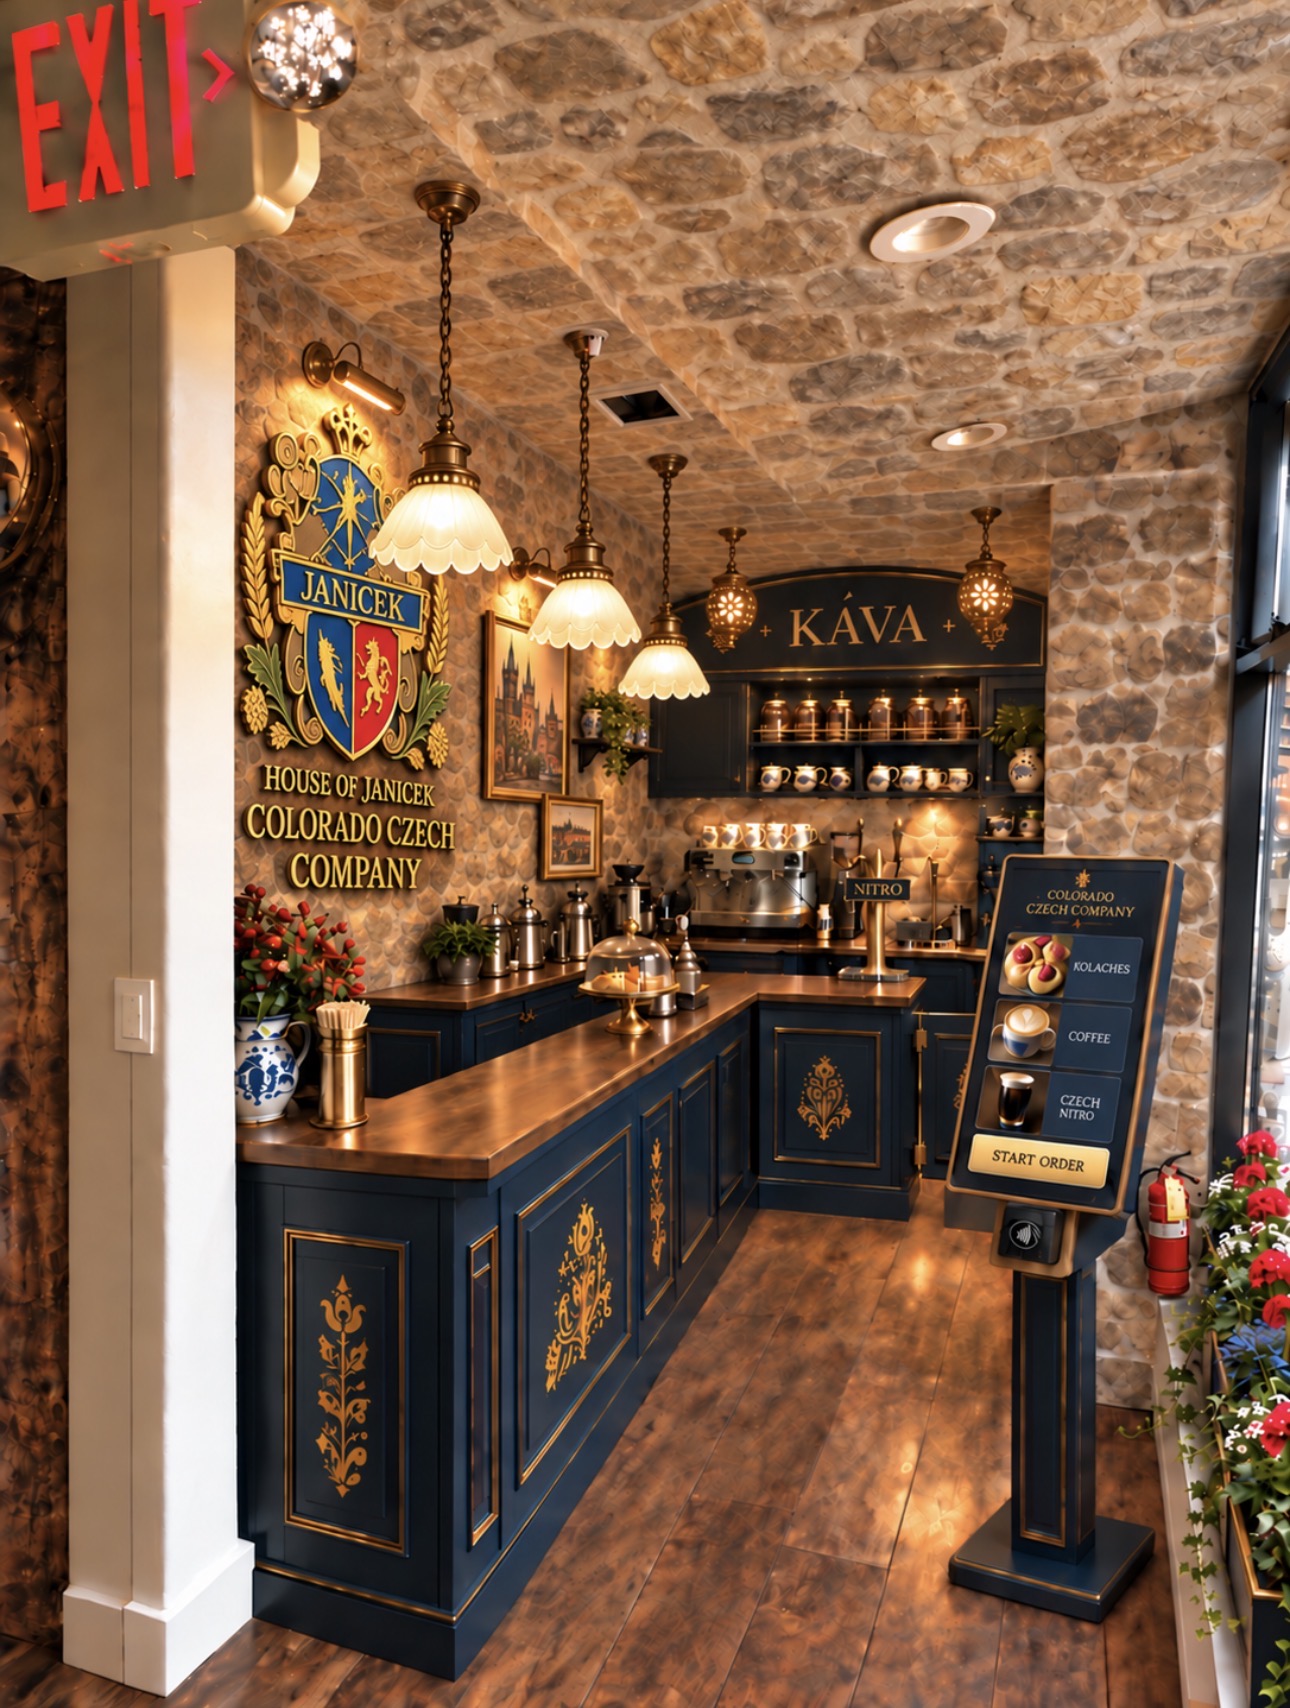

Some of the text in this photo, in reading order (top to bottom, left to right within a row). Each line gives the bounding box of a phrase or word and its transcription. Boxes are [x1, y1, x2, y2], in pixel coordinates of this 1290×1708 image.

[12, 0, 202, 213] EXIT
[301, 571, 405, 622] JANICEK
[789, 591, 928, 647] KÁVA
[264, 765, 436, 807] HOUSE OF JANICEK
[246, 803, 456, 850] COLORADO CZECH
[290, 852, 423, 890] COMPANY
[854, 883, 903, 896] NITRO
[1047, 890, 1115, 903] COLORADO
[1026, 903, 1136, 918] CZECH COMPANY
[1073, 961, 1131, 975] KOLACHES
[1068, 1031, 1112, 1045] COFFEE
[1060, 1094, 1101, 1109] CZECH
[1059, 1108, 1095, 1121] NITRO
[992, 1149, 1085, 1173] START ORDER
